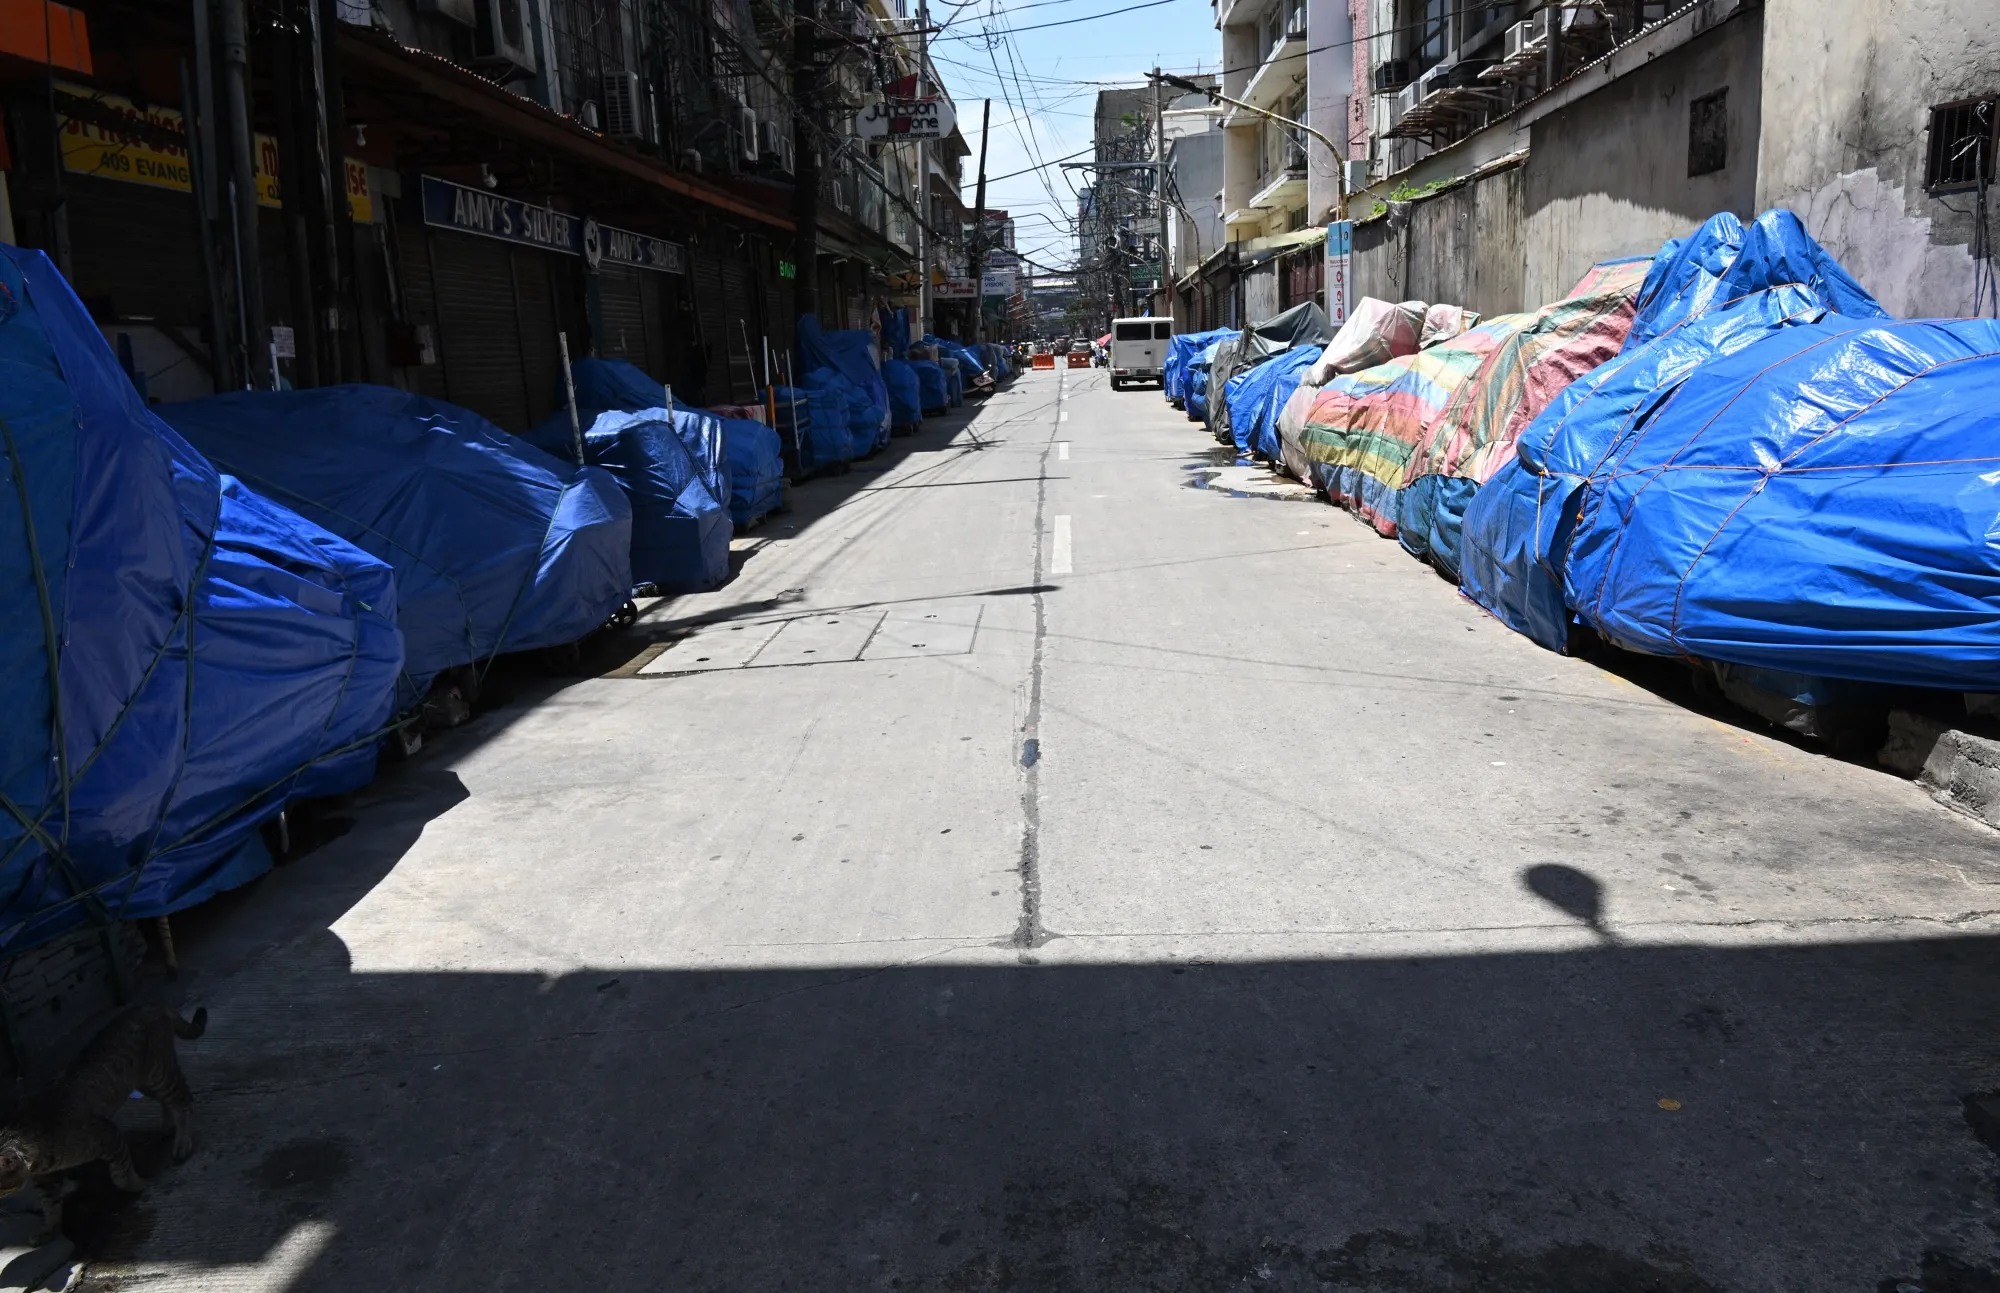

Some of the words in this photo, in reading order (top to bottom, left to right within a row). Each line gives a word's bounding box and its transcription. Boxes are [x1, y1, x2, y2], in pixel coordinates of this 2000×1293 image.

[101, 151, 131, 172] 409
[136, 158, 190, 184] EVANG
[454, 188, 512, 235] AMY'S
[521, 204, 572, 247] SILVER
[609, 229, 643, 262] AMY'S
[649, 240, 680, 268] SILVER
